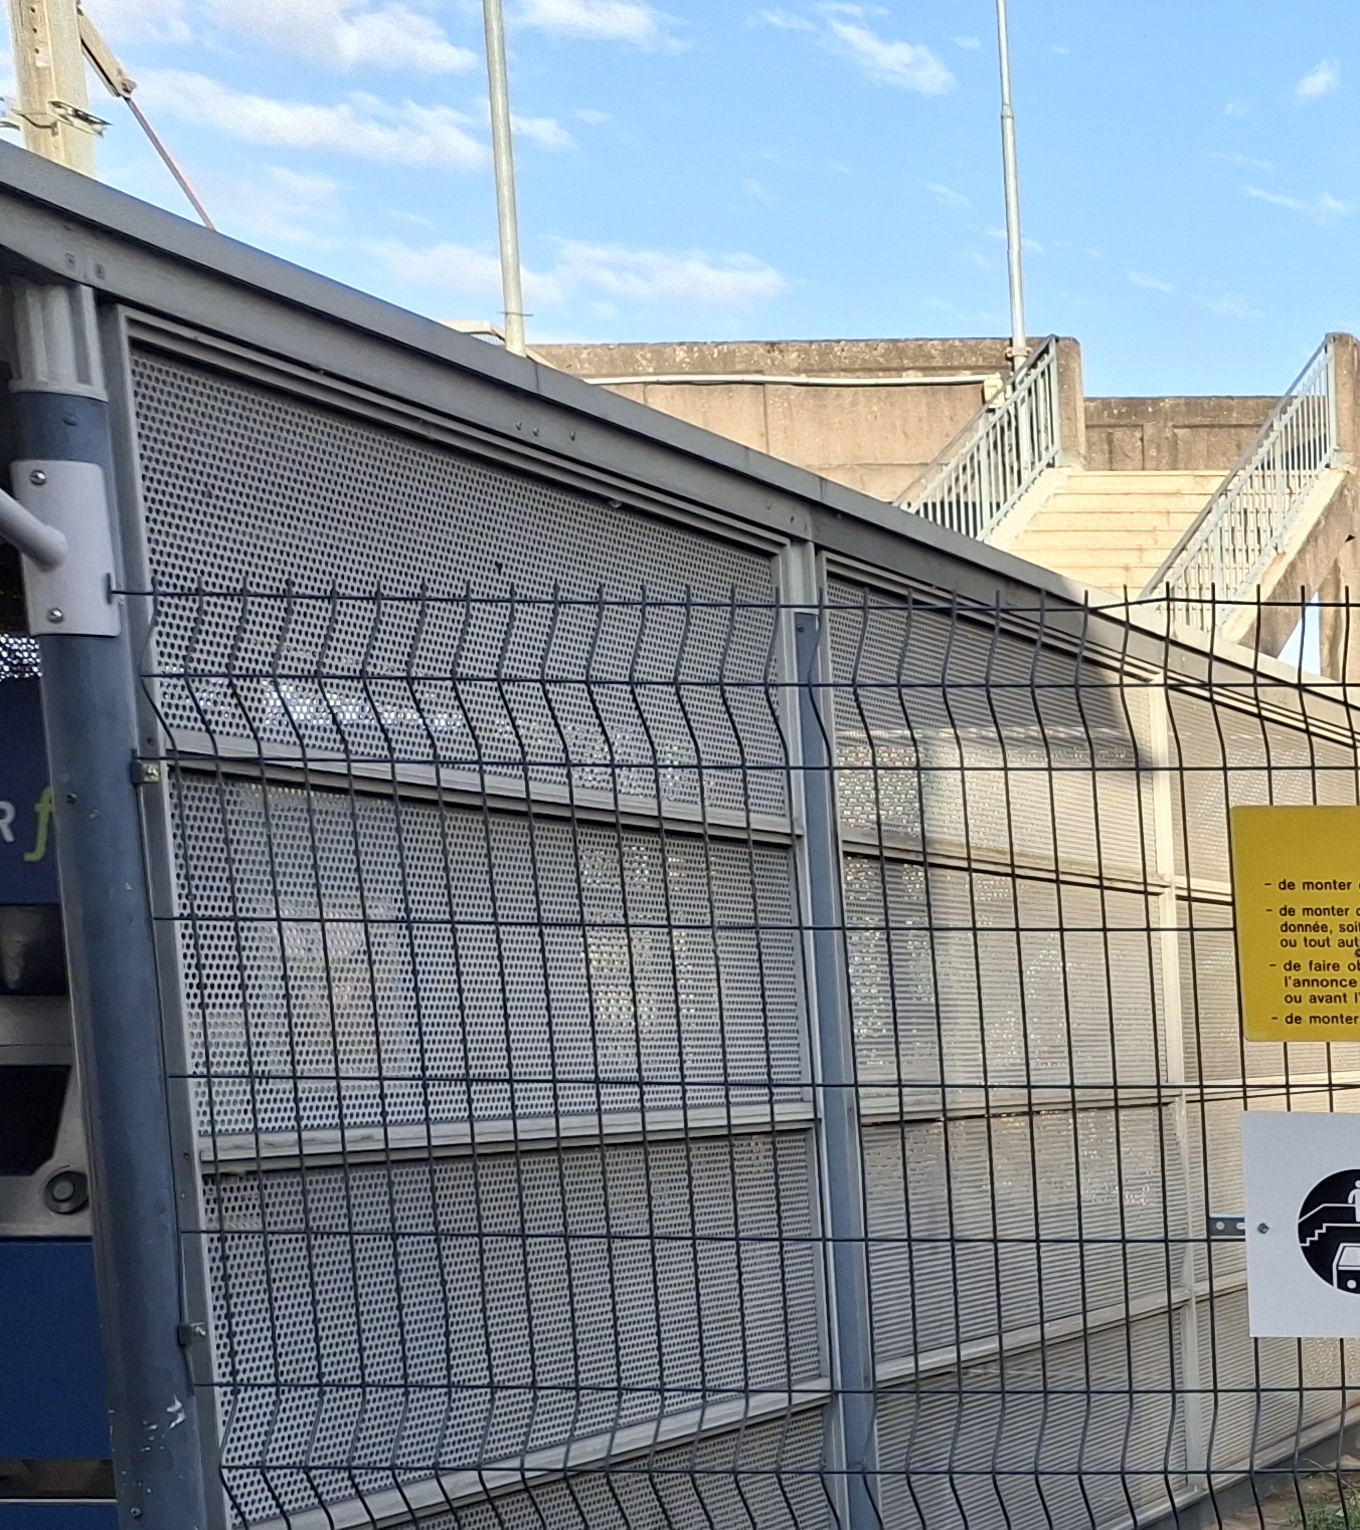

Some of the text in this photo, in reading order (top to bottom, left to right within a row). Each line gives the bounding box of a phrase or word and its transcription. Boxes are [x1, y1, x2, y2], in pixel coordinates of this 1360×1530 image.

[1277, 878, 1295, 890] de
[1301, 878, 1352, 890] monter
[1283, 958, 1301, 971] de
[1308, 959, 1340, 971] faire
[1283, 975, 1358, 988] l'annonce
[1283, 993, 1301, 1003] ou
[1308, 992, 1347, 1003] avant
[1284, 1012, 1302, 1024] de
[1308, 1013, 1359, 1024] monter
